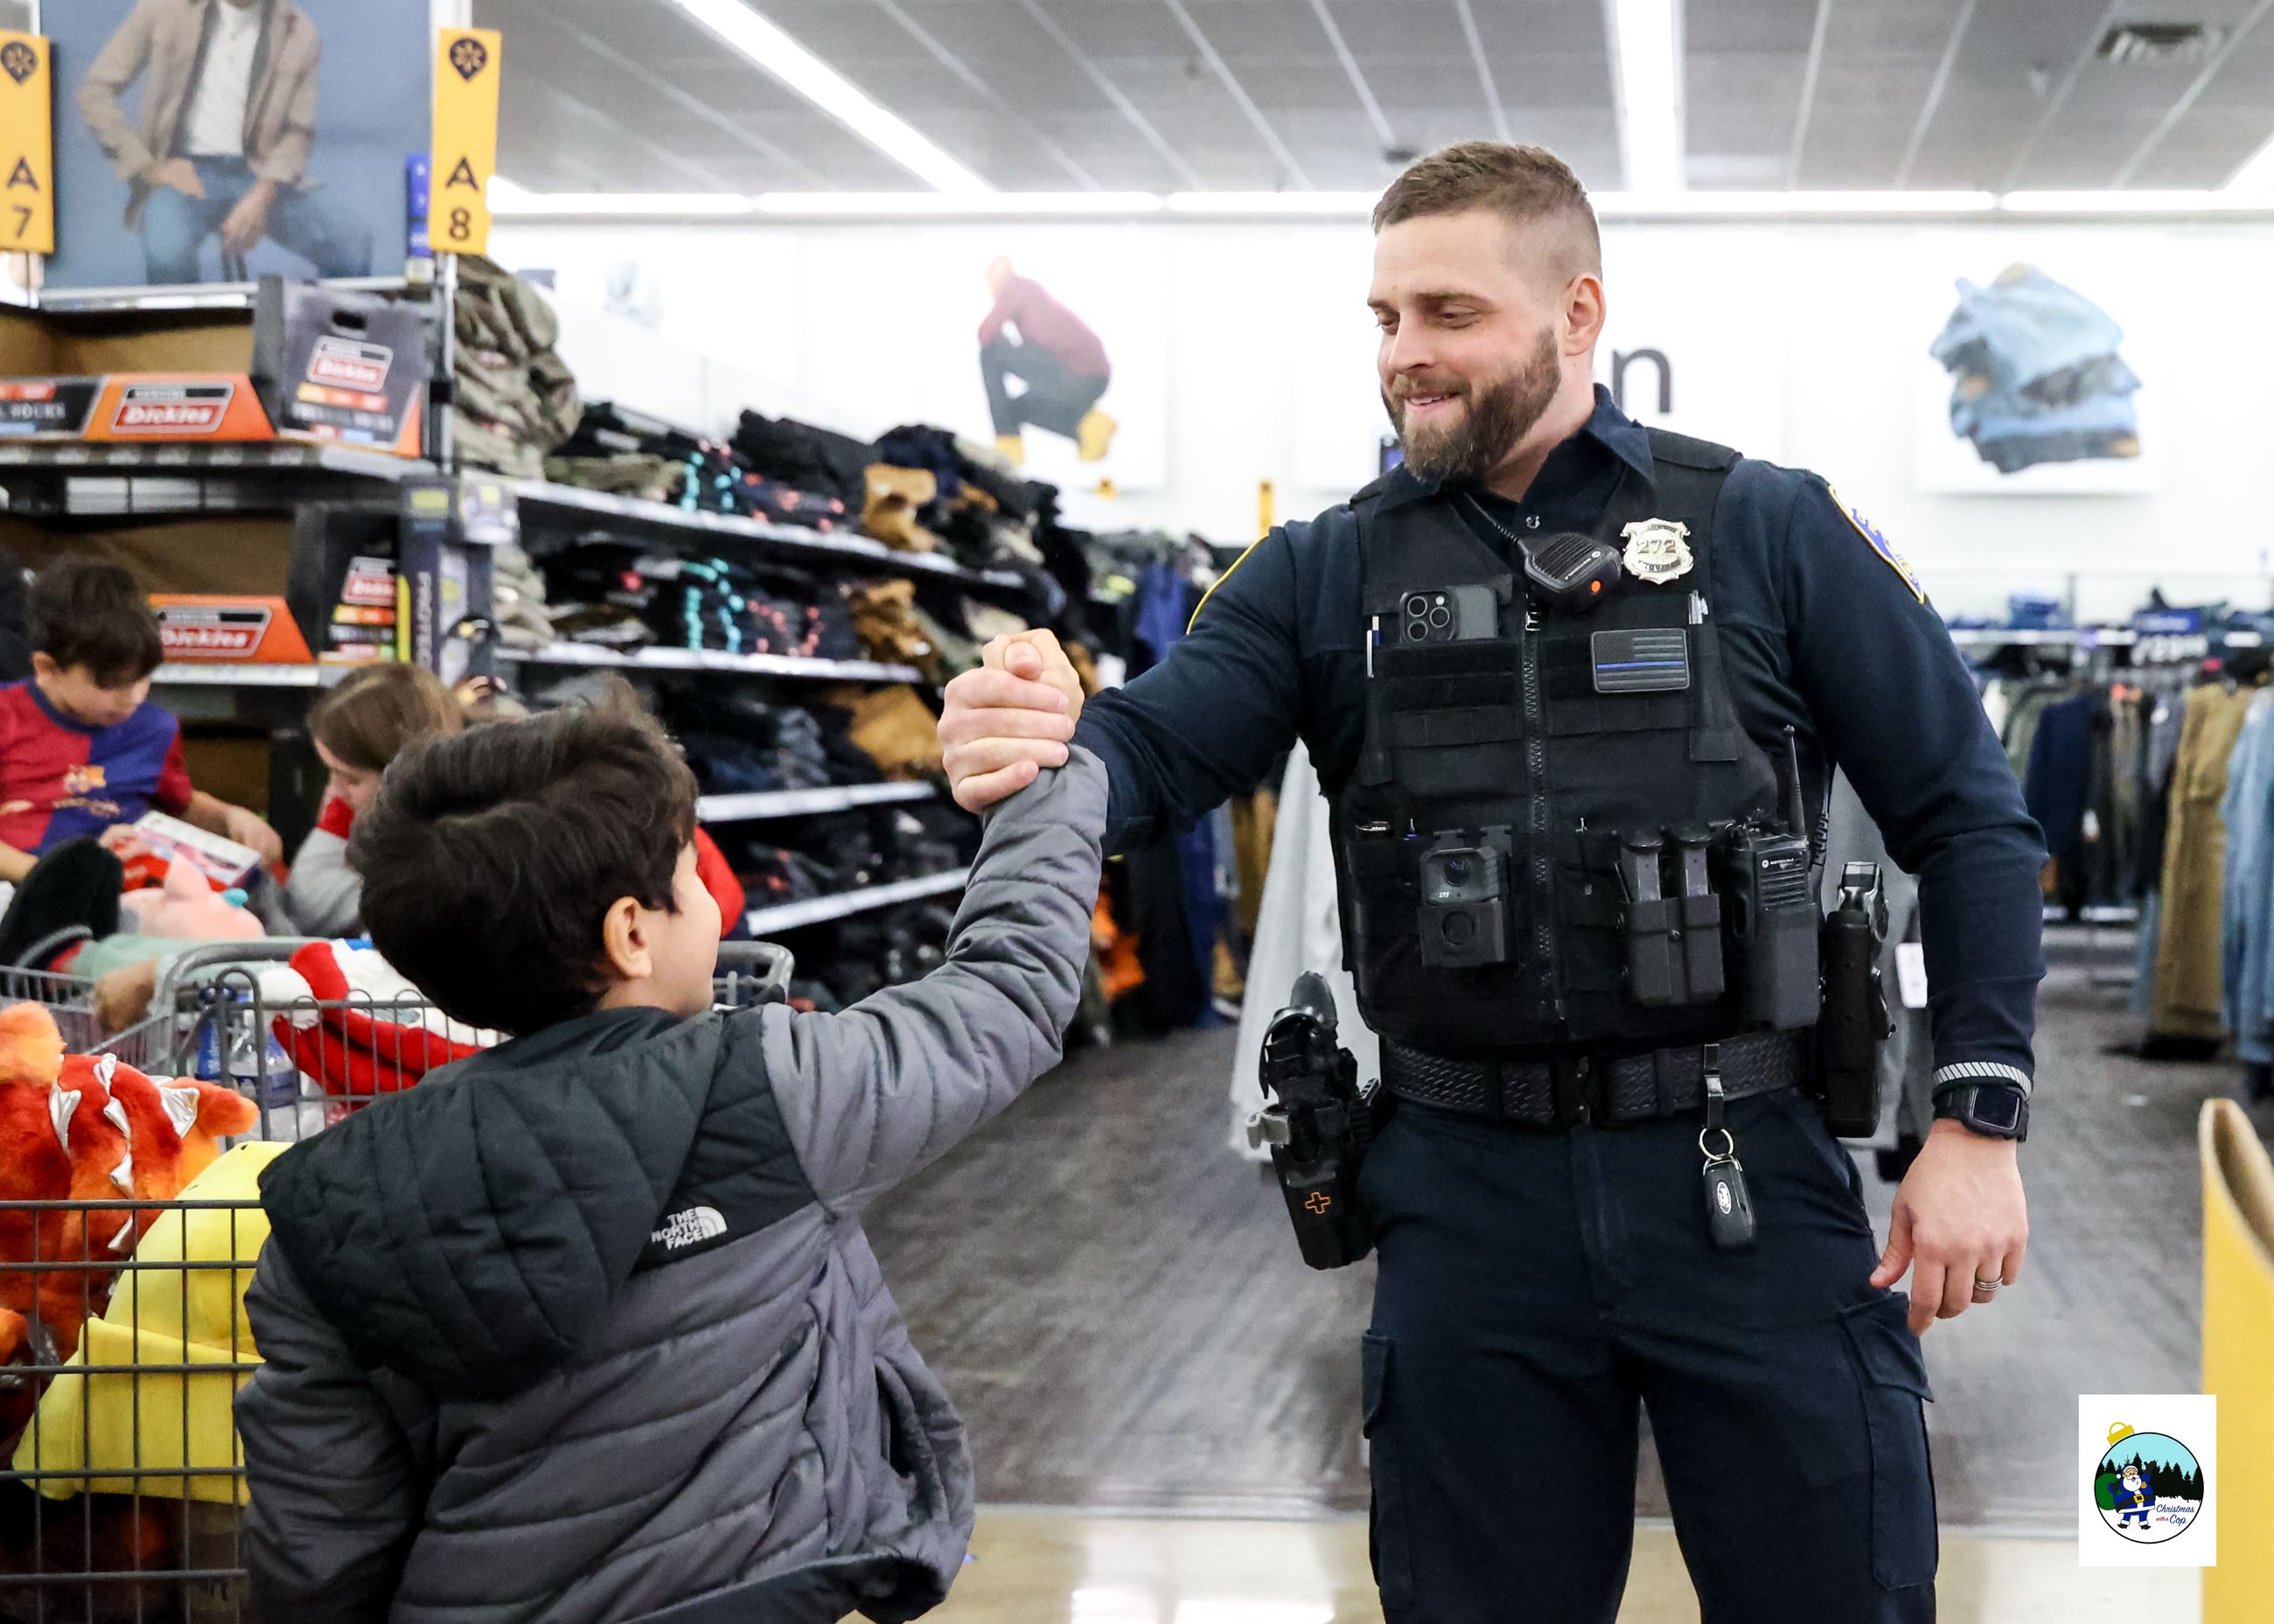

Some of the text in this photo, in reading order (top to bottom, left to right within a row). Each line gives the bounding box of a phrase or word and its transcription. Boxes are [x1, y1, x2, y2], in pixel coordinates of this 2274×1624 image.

[7, 157, 39, 191] A
[445, 157, 479, 192] A
[13, 206, 32, 238] 7
[449, 207, 471, 240] 8
[122, 406, 213, 426] Dickies
[1636, 539, 1677, 554] 272
[667, 1209, 696, 1225] THE
[651, 1219, 702, 1244] NORTH
[666, 1229, 703, 1251] FACE
